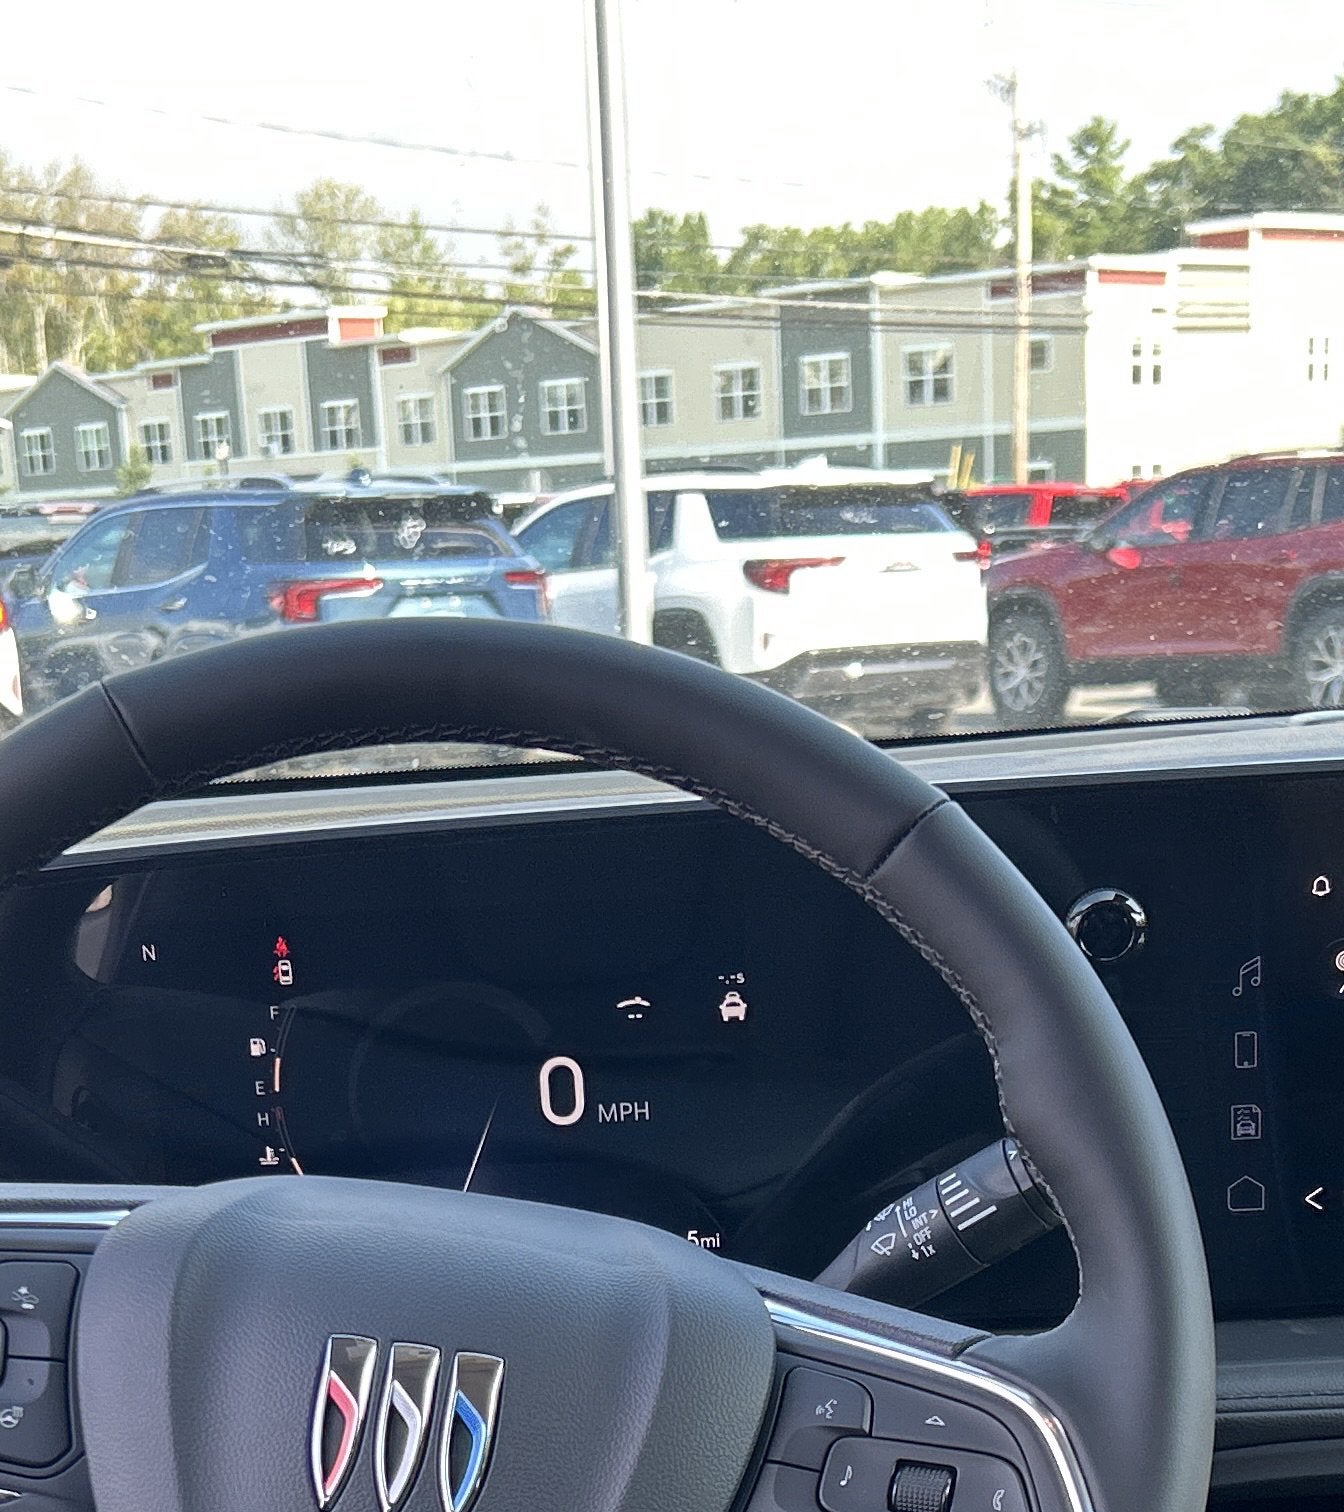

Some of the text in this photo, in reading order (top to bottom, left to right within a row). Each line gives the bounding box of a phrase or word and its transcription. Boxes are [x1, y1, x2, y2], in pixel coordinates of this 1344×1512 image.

[141, 944, 157, 962] N
[269, 1005, 280, 1020] F
[255, 1080, 266, 1096] E
[539, 1055, 650, 1126] 0 MPH
[257, 1112, 270, 1127] H
[903, 1206, 918, 1221] LO
[911, 1212, 929, 1230] INT
[912, 1226, 932, 1246] OFF
